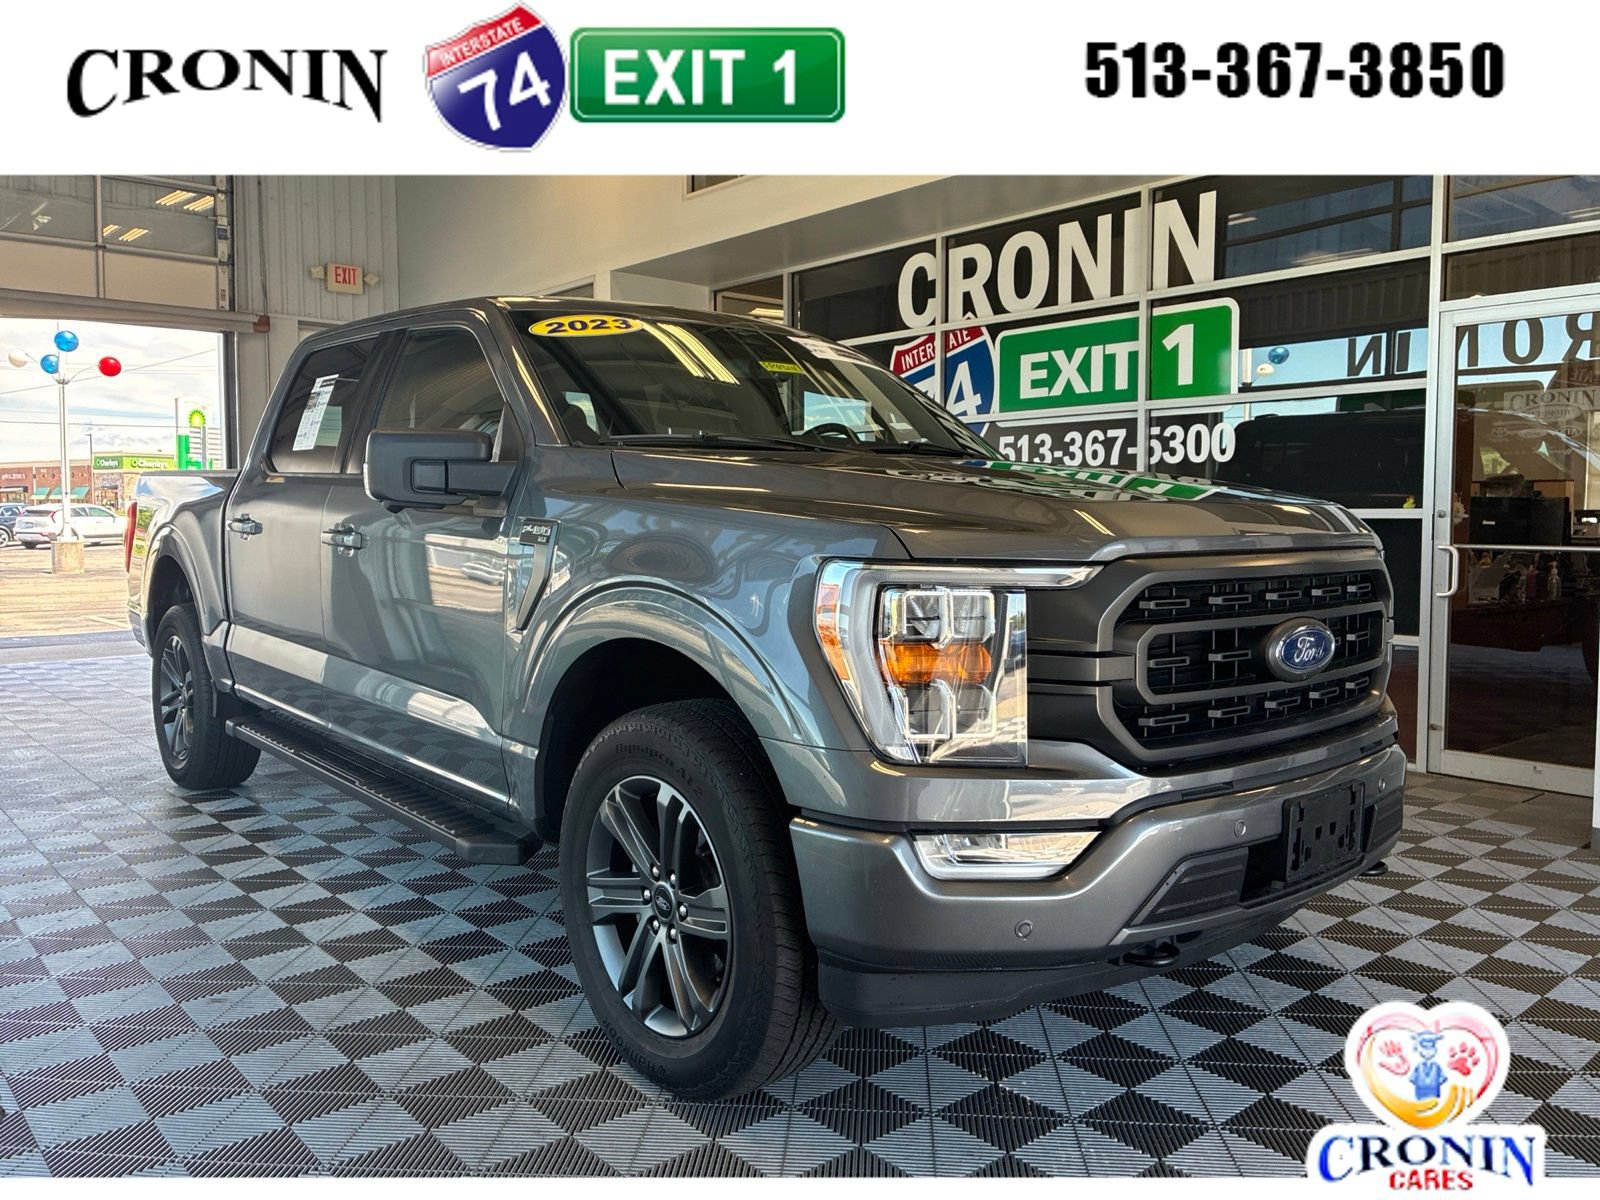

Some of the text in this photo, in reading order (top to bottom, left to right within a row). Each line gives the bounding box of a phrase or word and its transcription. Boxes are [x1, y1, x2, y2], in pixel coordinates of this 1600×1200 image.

[334, 266, 358, 285] EXIT
[898, 191, 1217, 329] CRONIN
[545, 319, 632, 334] 2023
[1020, 323, 1194, 399] EXIT 1
[999, 422, 1236, 467] 513-367-5300
[1294, 636, 1326, 662] Ford
